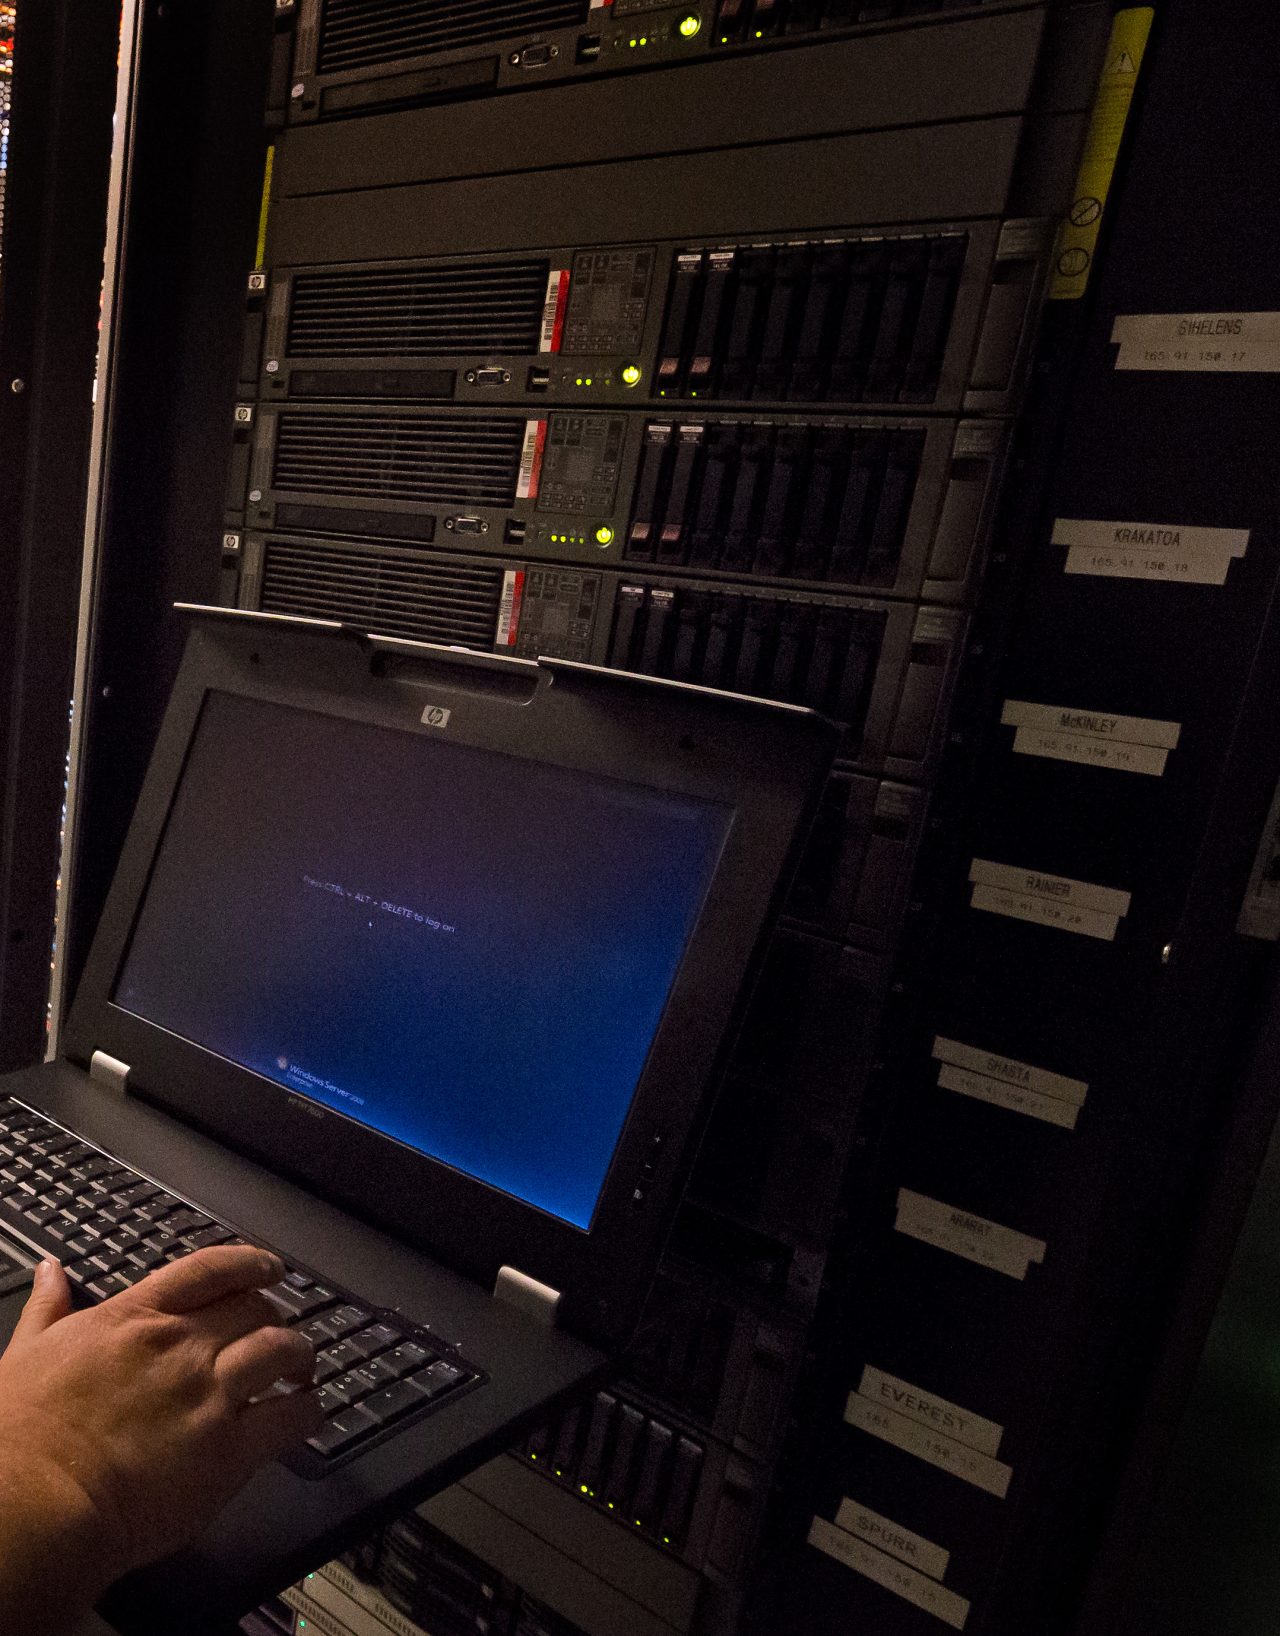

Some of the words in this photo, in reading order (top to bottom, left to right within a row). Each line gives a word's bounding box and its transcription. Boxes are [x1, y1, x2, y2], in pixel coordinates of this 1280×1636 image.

[1113, 528, 1181, 547] KRAKATOA
[1060, 713, 1117, 734] McKINLEY
[1026, 876, 1071, 897] RAINIER
[354, 892, 372, 904] ALT
[381, 901, 414, 920] DELETE
[414, 912, 424, 923] to
[425, 916, 441, 931] log
[442, 923, 456, 934] on
[289, 1064, 324, 1087] Windows
[879, 1382, 969, 1431] EVEREST
[856, 1514, 918, 1558] SPURR
